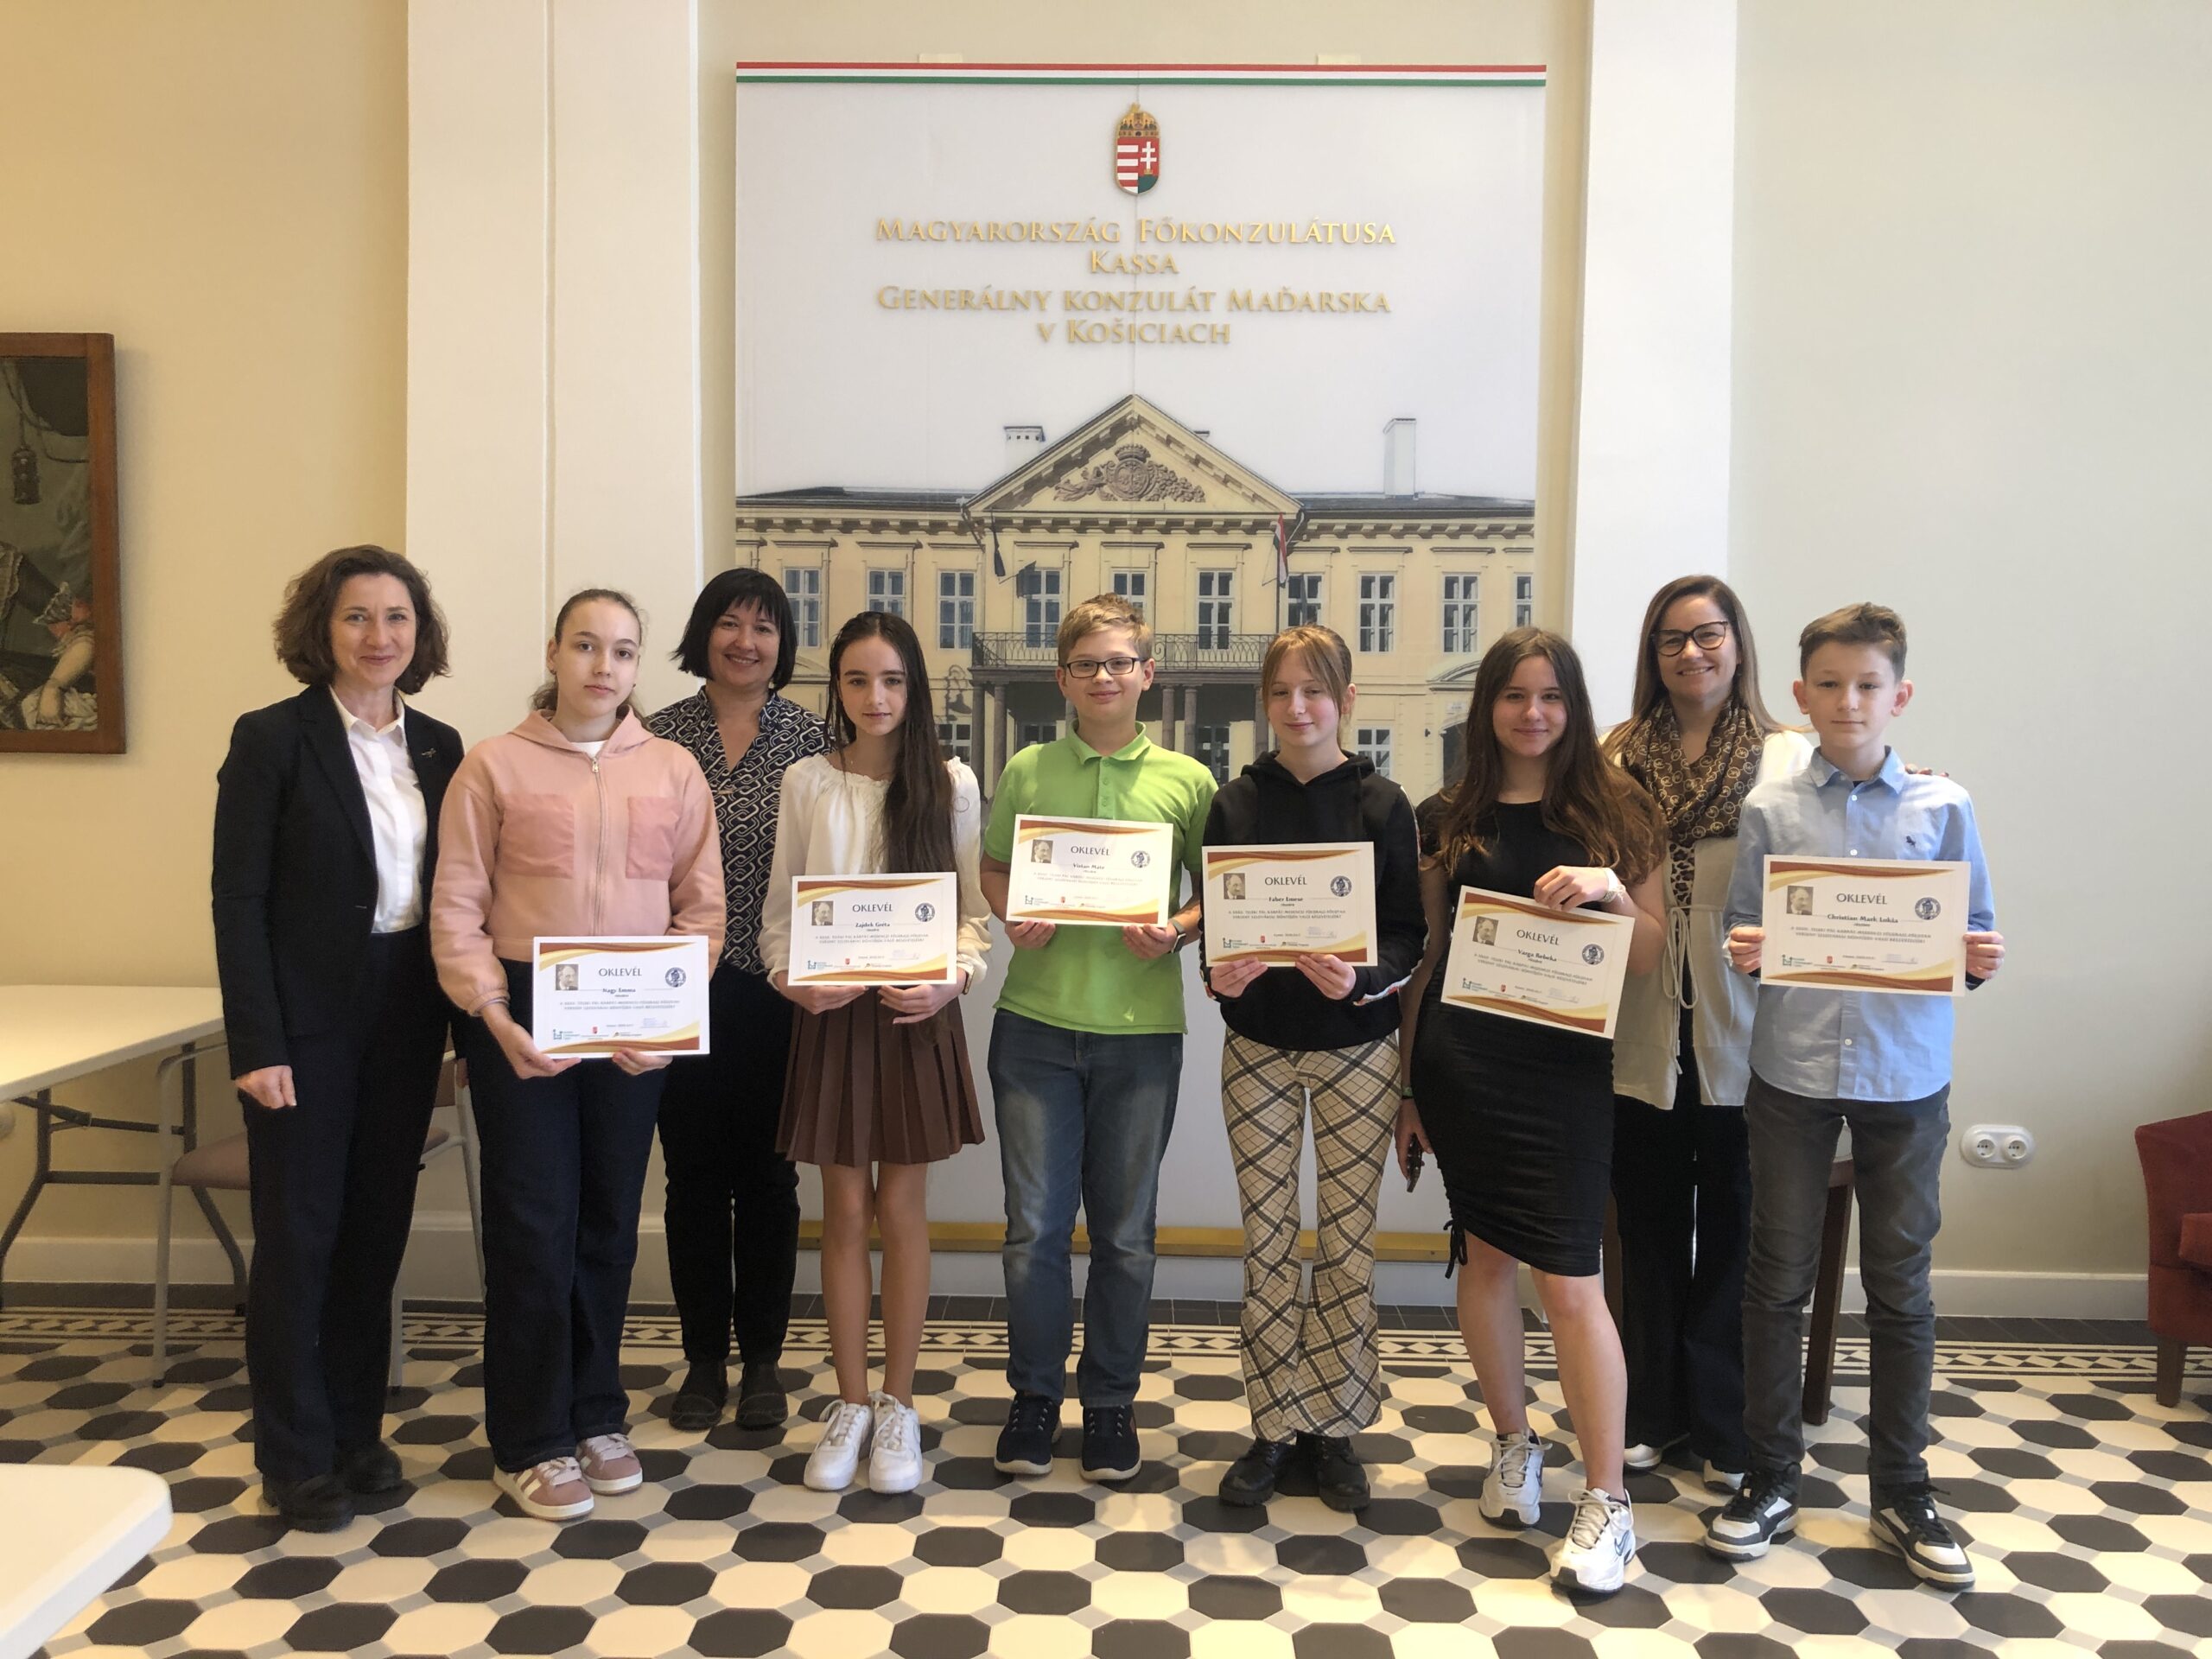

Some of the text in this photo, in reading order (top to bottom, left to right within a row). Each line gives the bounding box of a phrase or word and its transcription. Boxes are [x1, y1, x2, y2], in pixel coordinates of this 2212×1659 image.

[875, 216, 1396, 245] MAGYARORSZÁG FŐKONZULÁTUSA
[1090, 249, 1179, 275] KASSA
[878, 283, 1391, 314] GENERÁLNY KONZULÁT MAĎARSKA
[1067, 315, 1231, 345] KOŠICIACH
[1071, 845, 1110, 856] OKLEVÉL
[1264, 874, 1307, 886] OKLEVÉL
[1836, 892, 1887, 905] OKLEVÉL
[852, 902, 893, 912] OKLEVÉL
[1516, 929, 1560, 946] OKLEVÉL
[598, 966, 642, 977] OKLEVÉL
